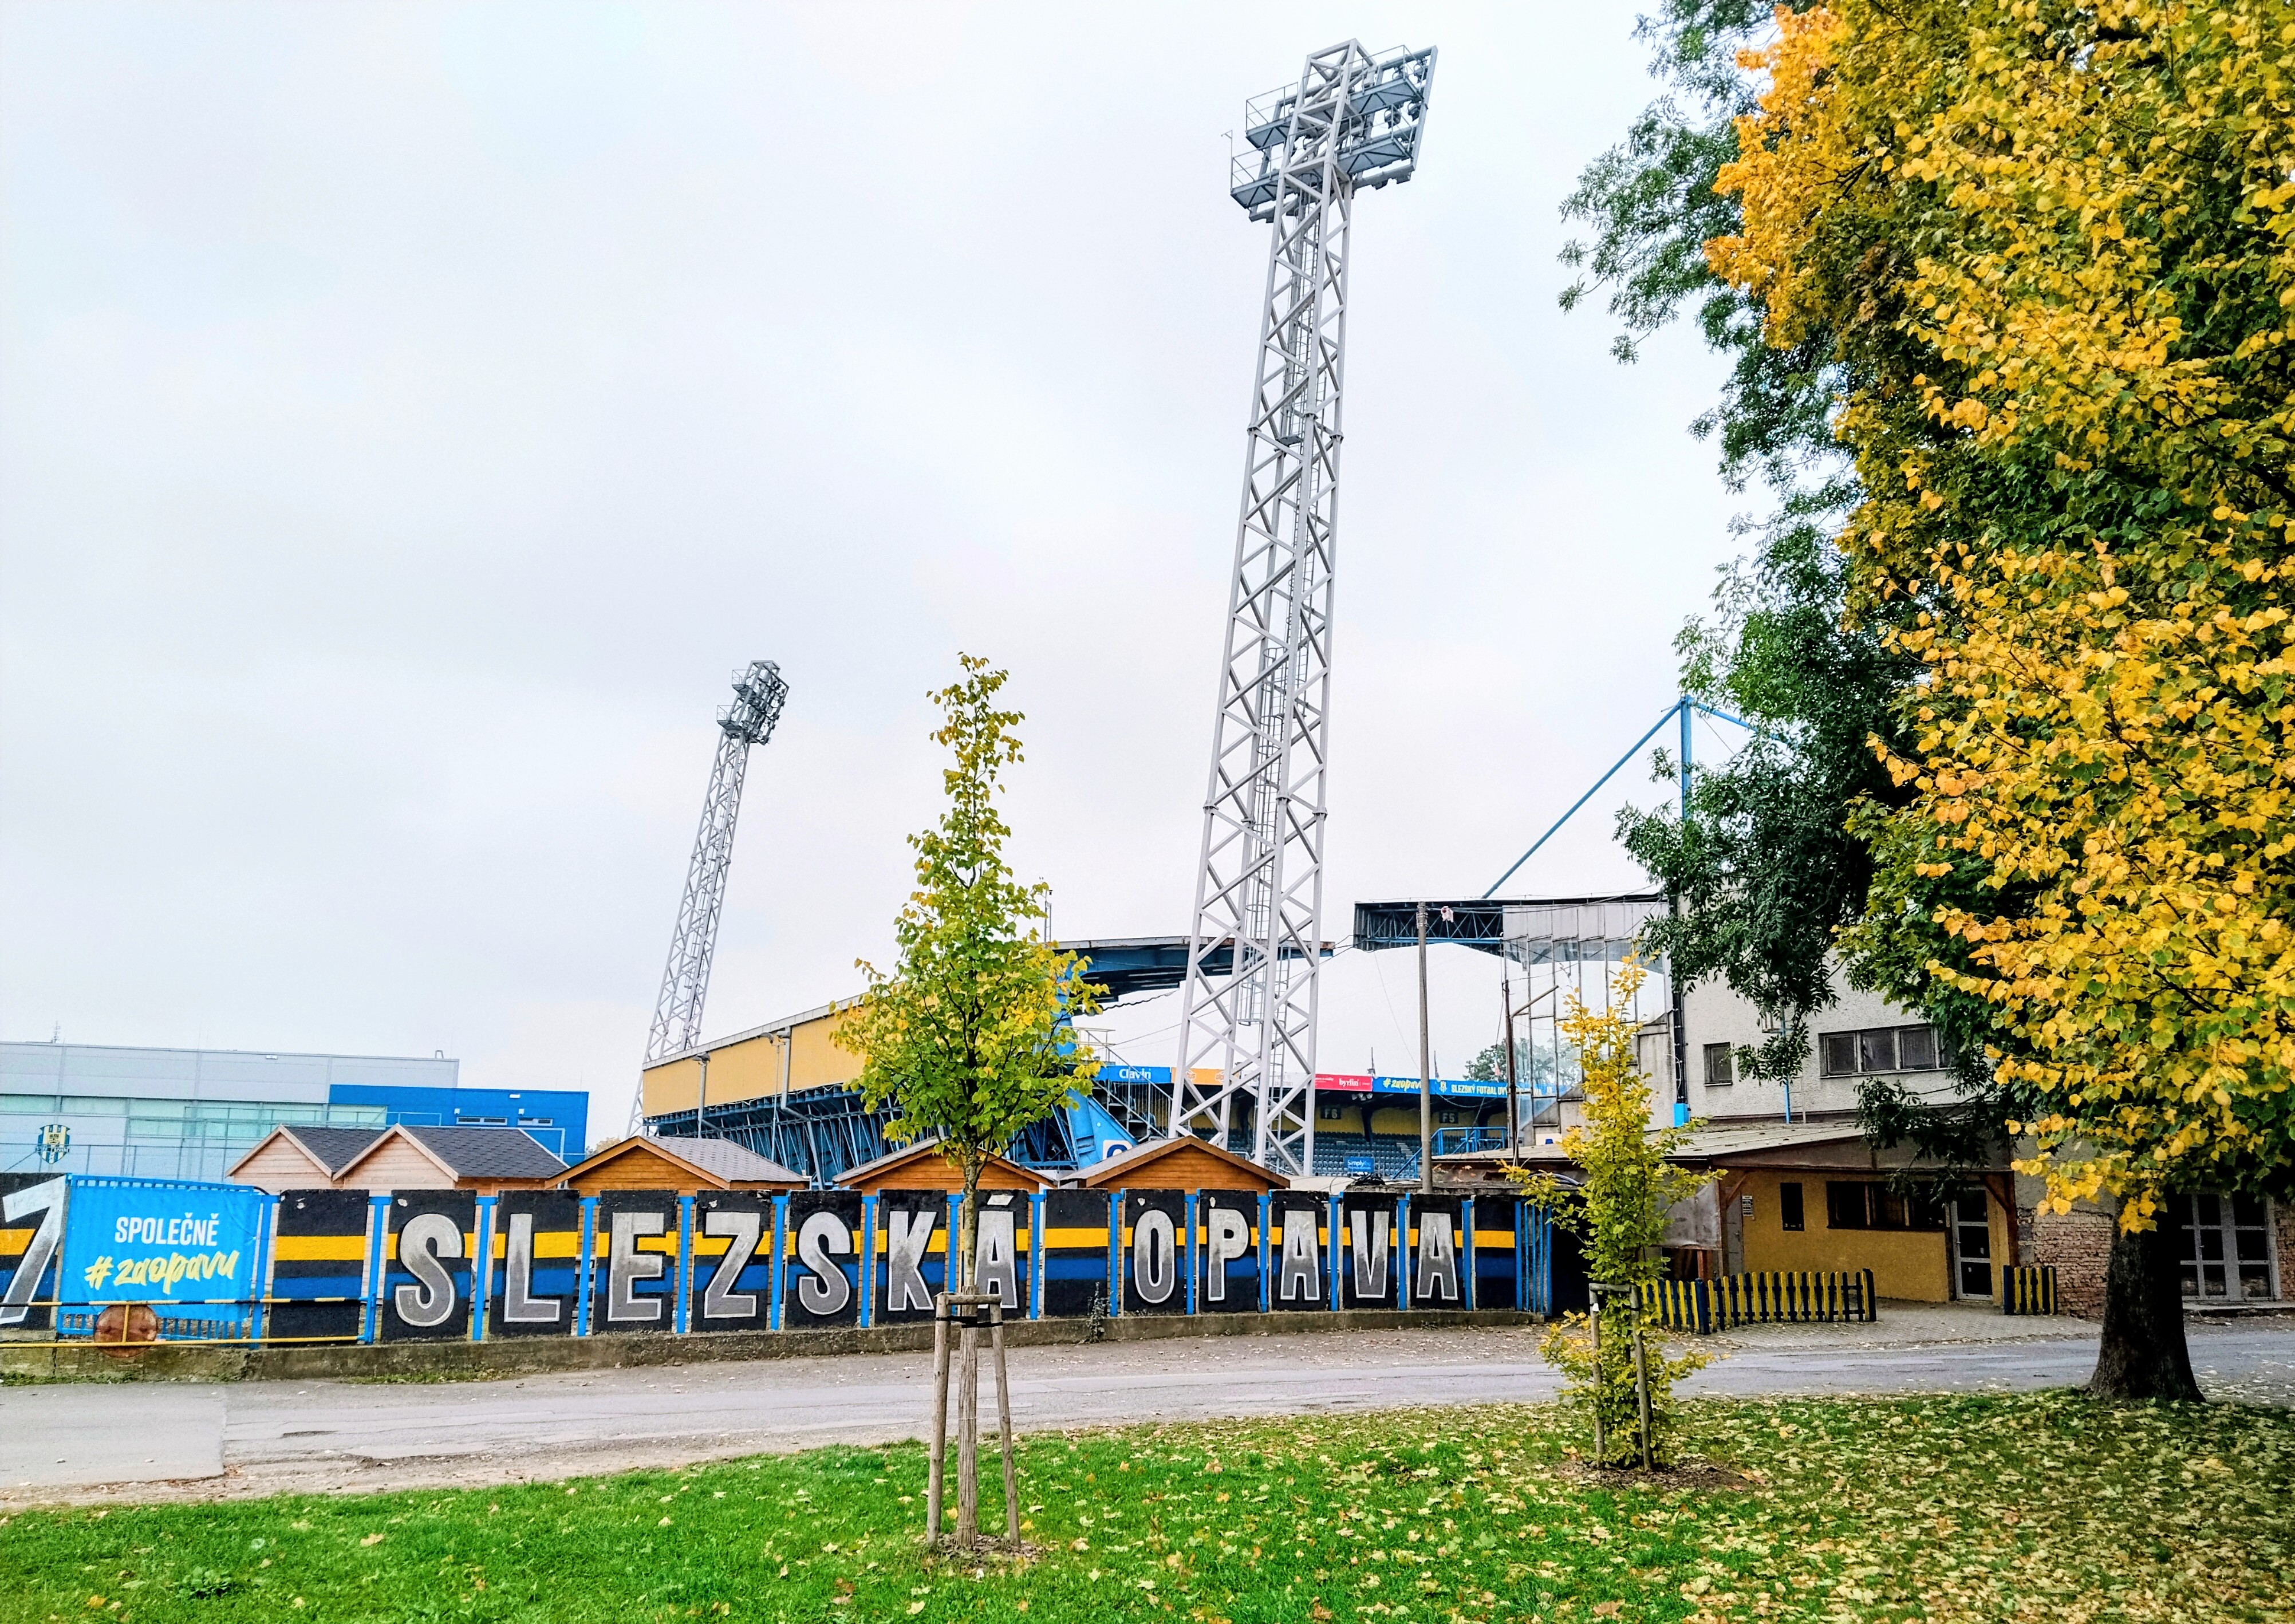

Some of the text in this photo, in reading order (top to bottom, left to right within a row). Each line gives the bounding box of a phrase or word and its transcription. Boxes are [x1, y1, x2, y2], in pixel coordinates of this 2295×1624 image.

[1383, 1078, 1421, 1092] #zaopav
[1442, 1113, 1455, 1123] F5
[115, 1212, 219, 1246] SPOLEČNĚ
[84, 1249, 240, 1295] #zaopavu
[395, 1195, 1458, 1327] SLEZSKÁ OPAVA
